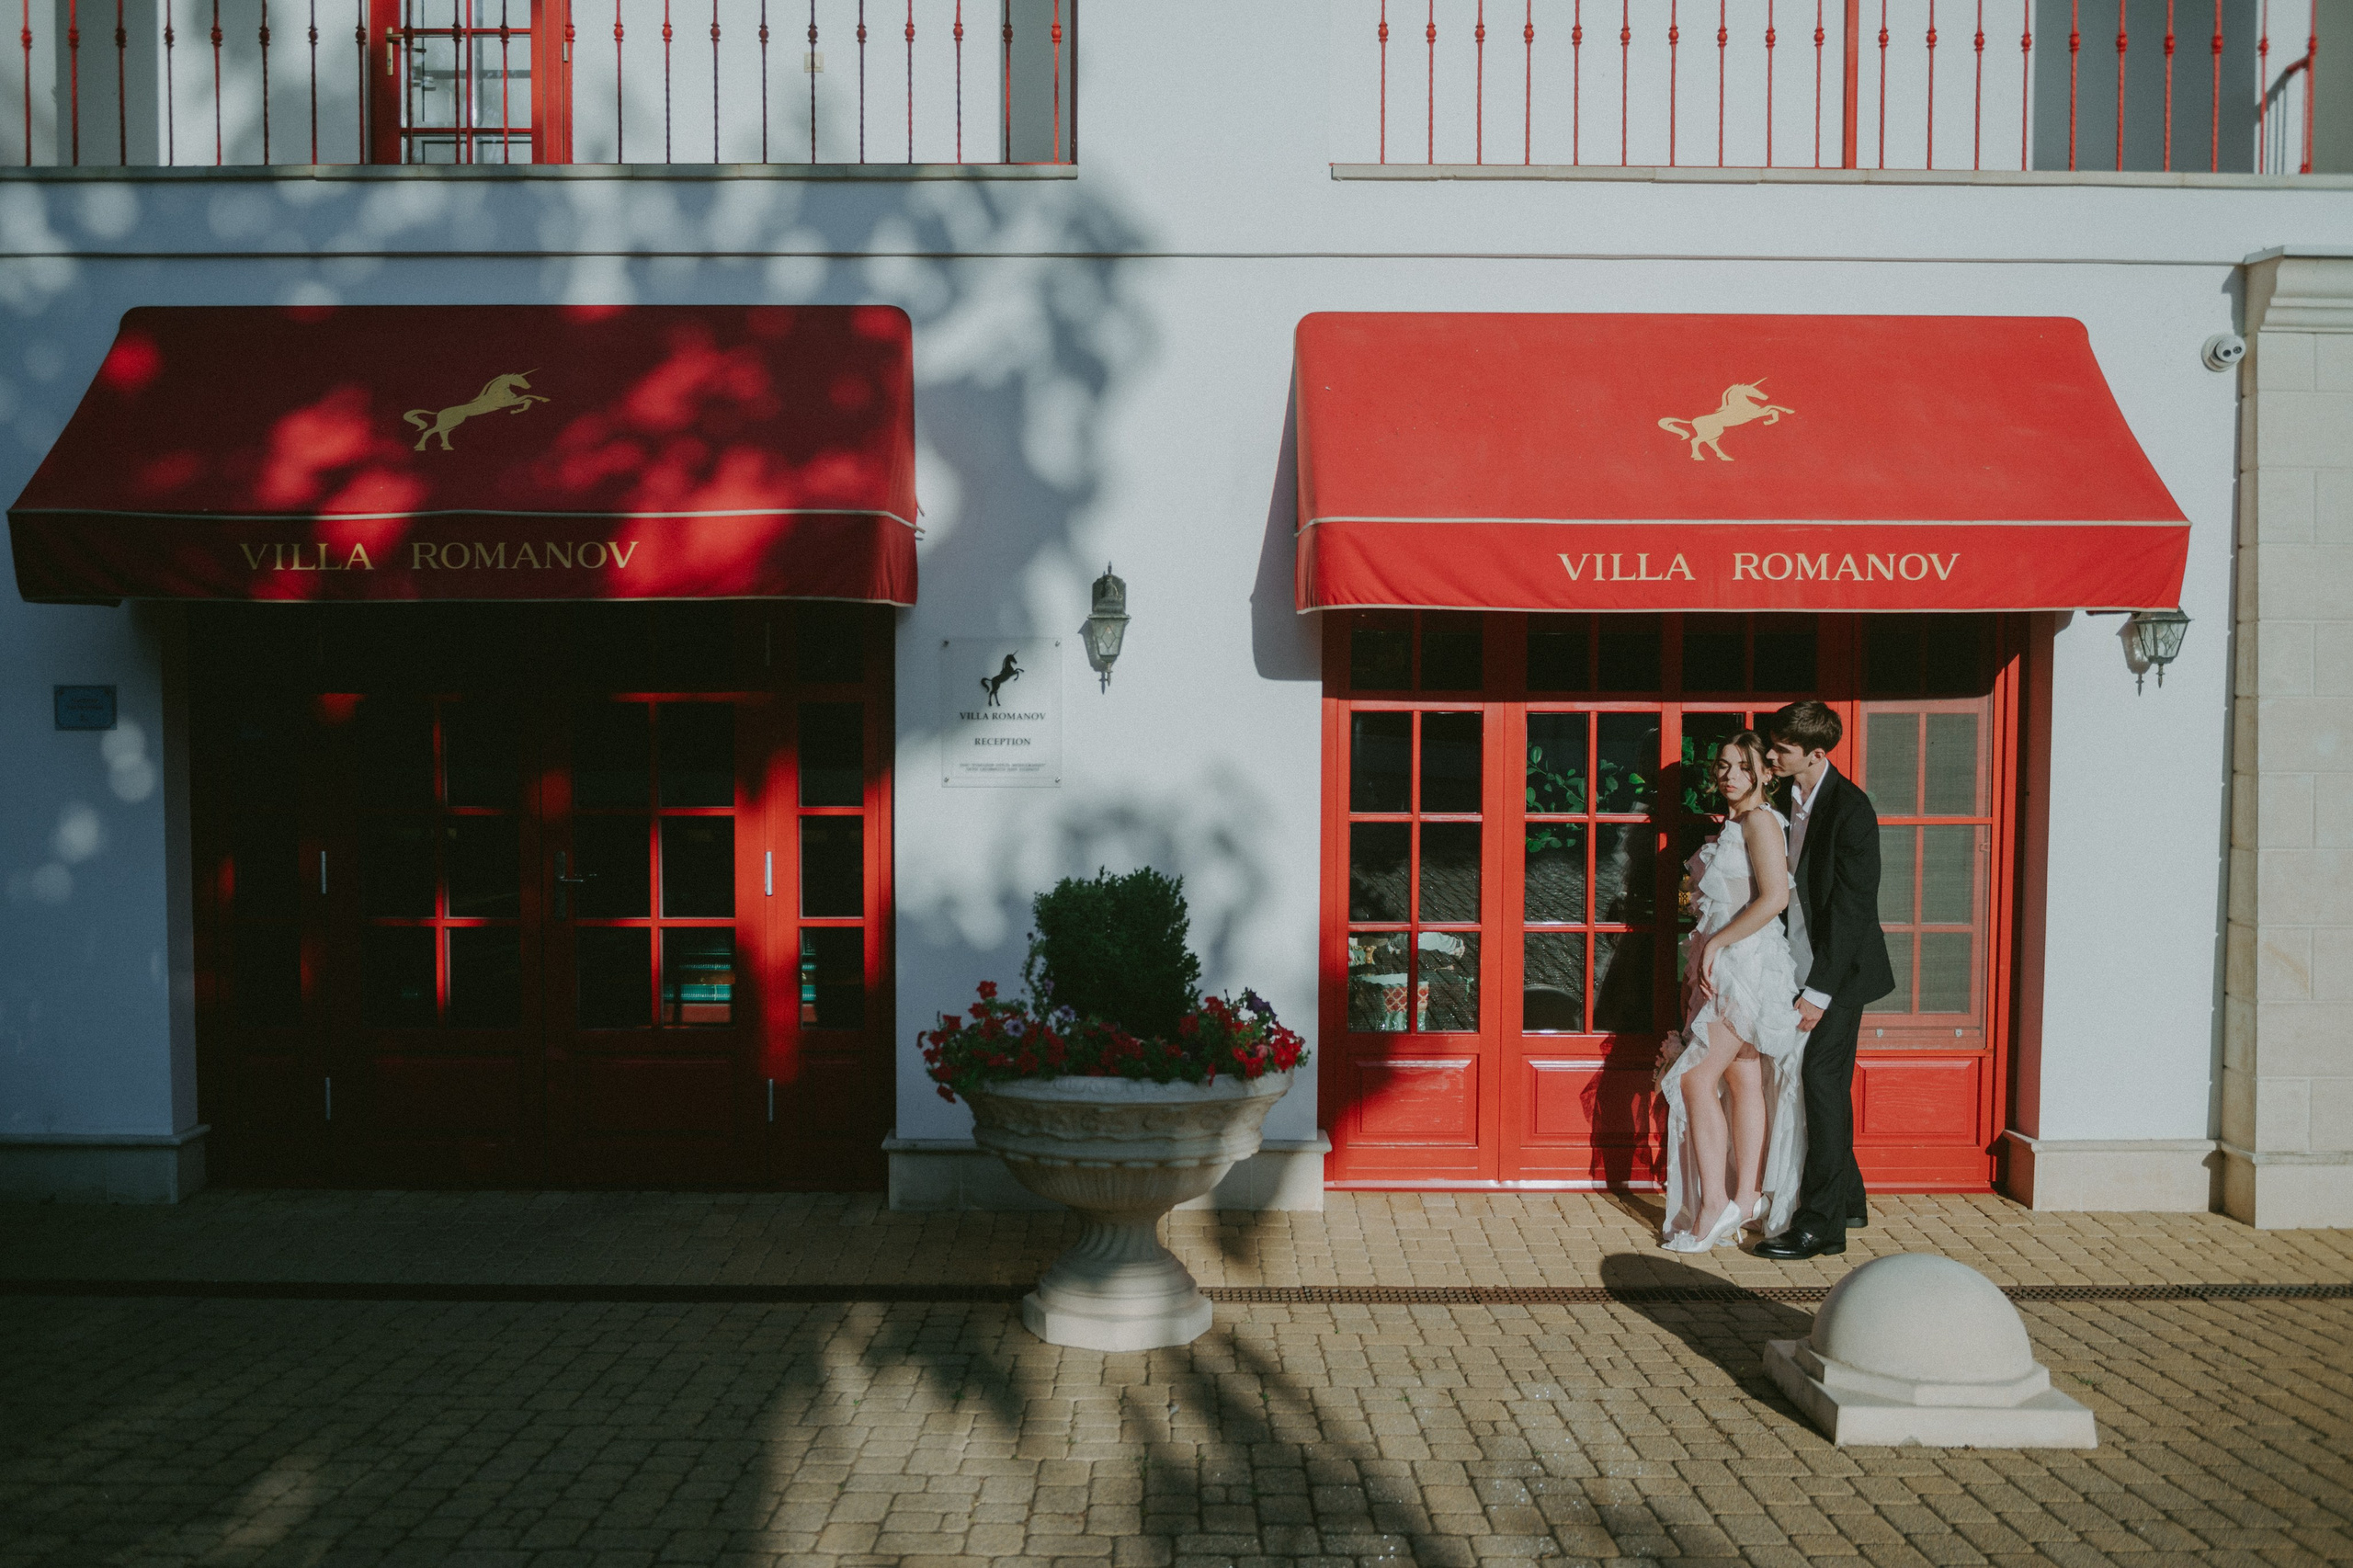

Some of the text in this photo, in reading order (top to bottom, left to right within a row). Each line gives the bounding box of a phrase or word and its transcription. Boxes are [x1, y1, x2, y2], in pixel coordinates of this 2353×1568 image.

[240, 541, 641, 571] VILLA ROMANOV
[1557, 552, 1961, 581] VILLA ROMANOV
[960, 711, 1046, 721] VILLA ROMANOV
[974, 737, 1031, 745] RECEPTION
